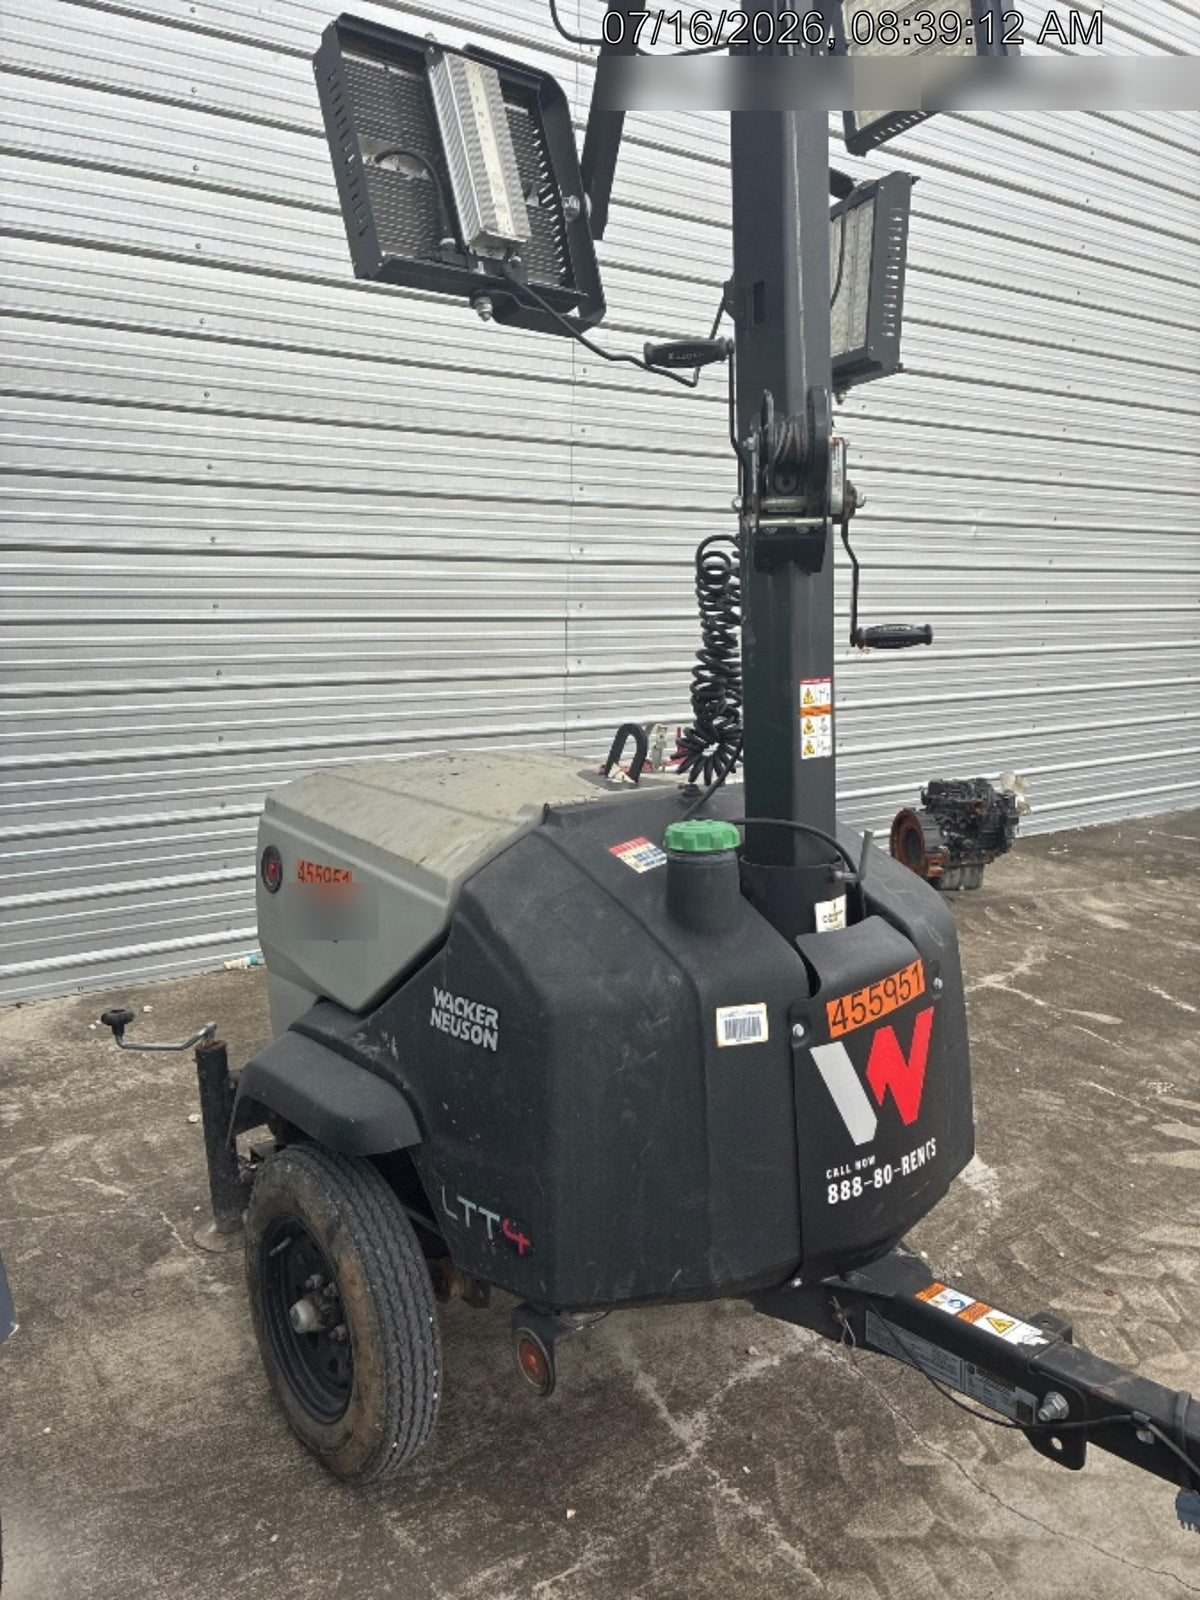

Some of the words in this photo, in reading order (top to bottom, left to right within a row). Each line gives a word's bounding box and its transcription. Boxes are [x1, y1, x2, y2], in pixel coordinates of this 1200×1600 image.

[433, 986, 499, 1030] WACKER
[832, 962, 922, 1030] 455951
[430, 1007, 499, 1052] NEUSON
[825, 1164, 852, 1179] CALL
[854, 1155, 876, 1170] NOW
[827, 1137, 937, 1204] 888-80-RENTS
[442, 1185, 530, 1256] LTT4
